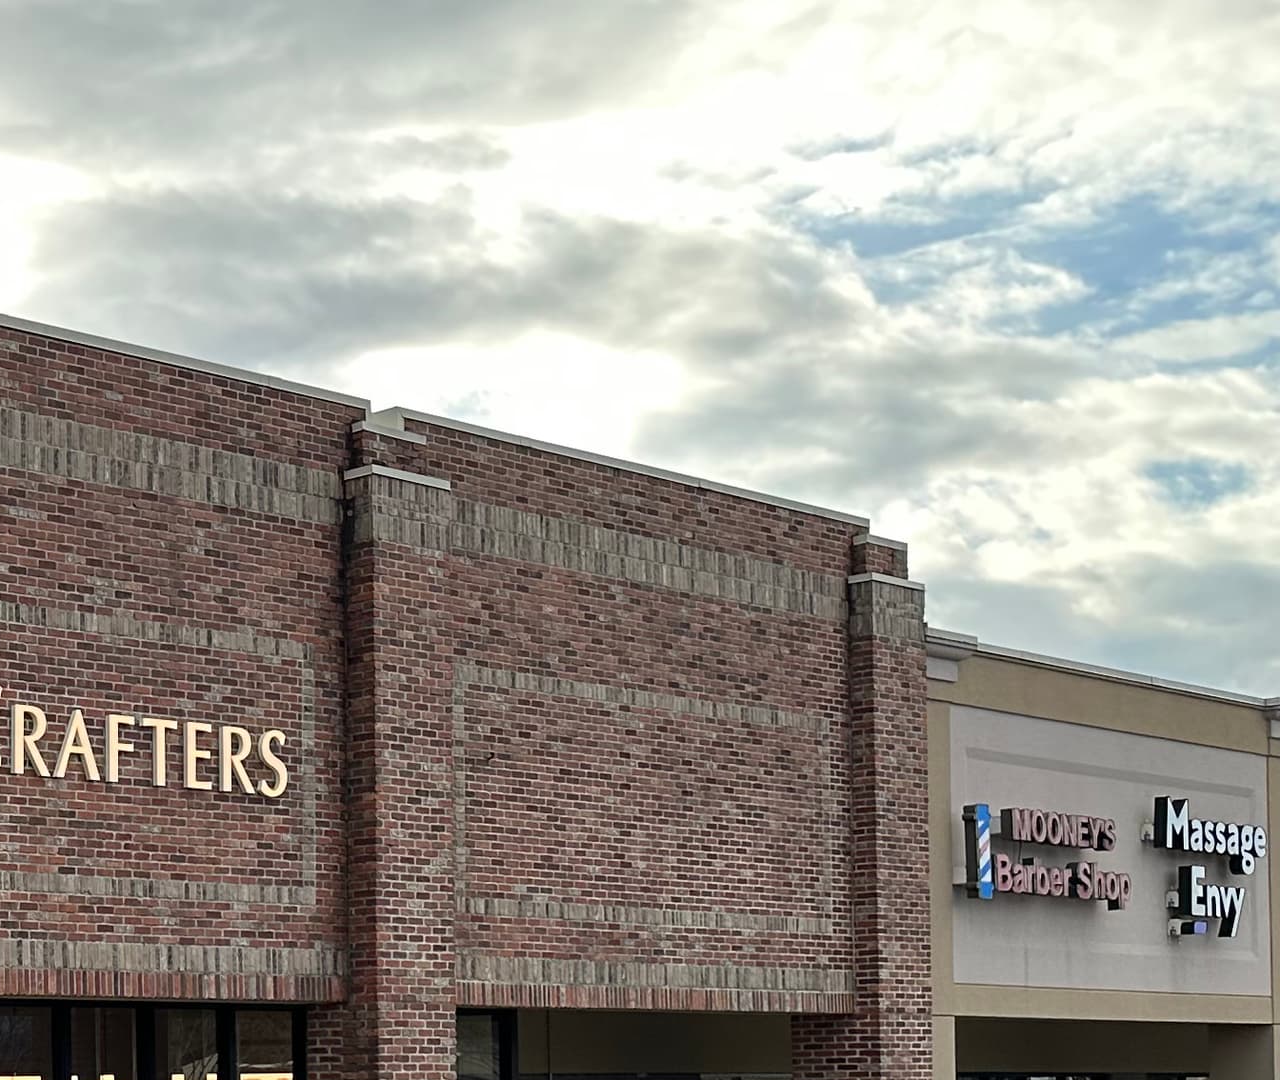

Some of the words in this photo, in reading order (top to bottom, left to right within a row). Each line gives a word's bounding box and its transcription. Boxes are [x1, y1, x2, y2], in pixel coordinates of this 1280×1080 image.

[1011, 808, 1117, 850] MOONEY'S
[1165, 797, 1267, 875] Massage
[995, 854, 1072, 898] Barber
[1076, 862, 1132, 909] Shop
[1190, 865, 1246, 938] Envy
